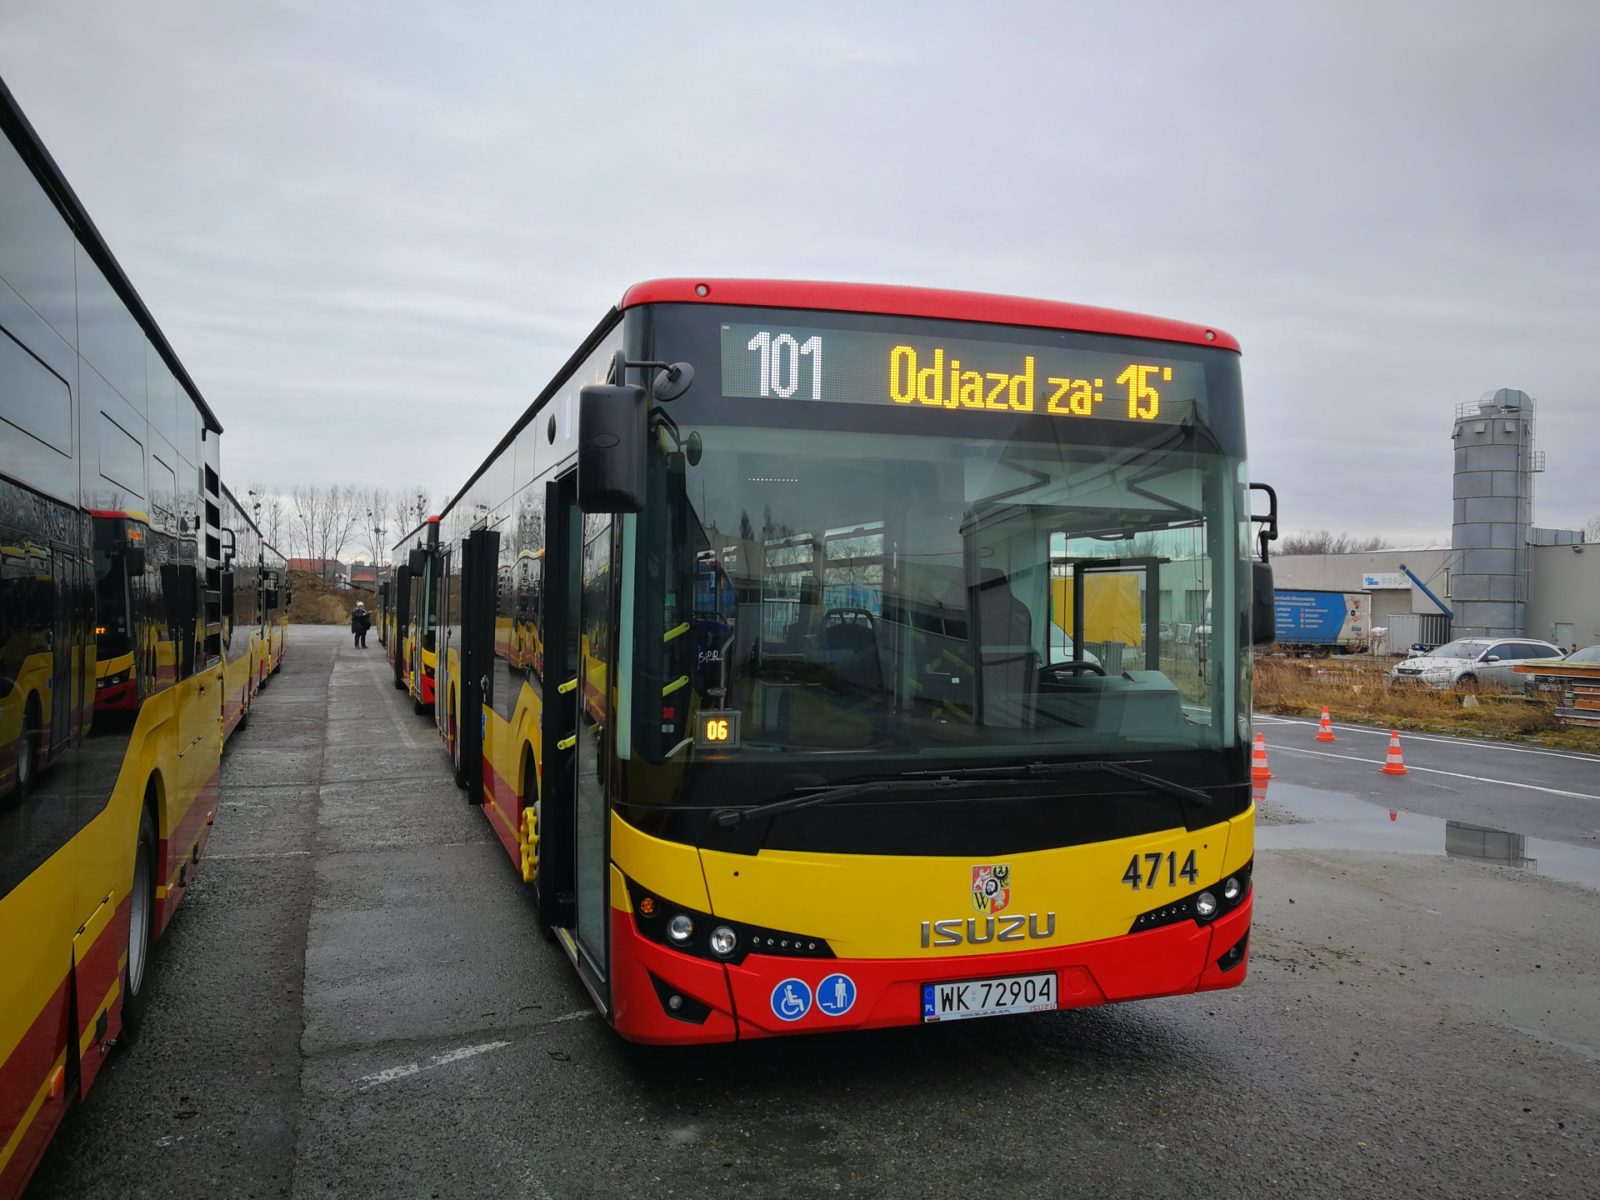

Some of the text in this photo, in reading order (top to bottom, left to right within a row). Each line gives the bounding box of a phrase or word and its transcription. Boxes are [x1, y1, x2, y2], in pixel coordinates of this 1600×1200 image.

[747, 331, 822, 400] 101
[889, 345, 1172, 420] Odjazd za: 15'
[707, 720, 728, 740] 06
[1122, 849, 1199, 890] 4714
[921, 911, 1056, 948] ISUZU
[925, 1004, 934, 1012] PL
[941, 977, 1050, 1012] WK 72904
[1029, 1003, 1057, 1012] ISUZU
